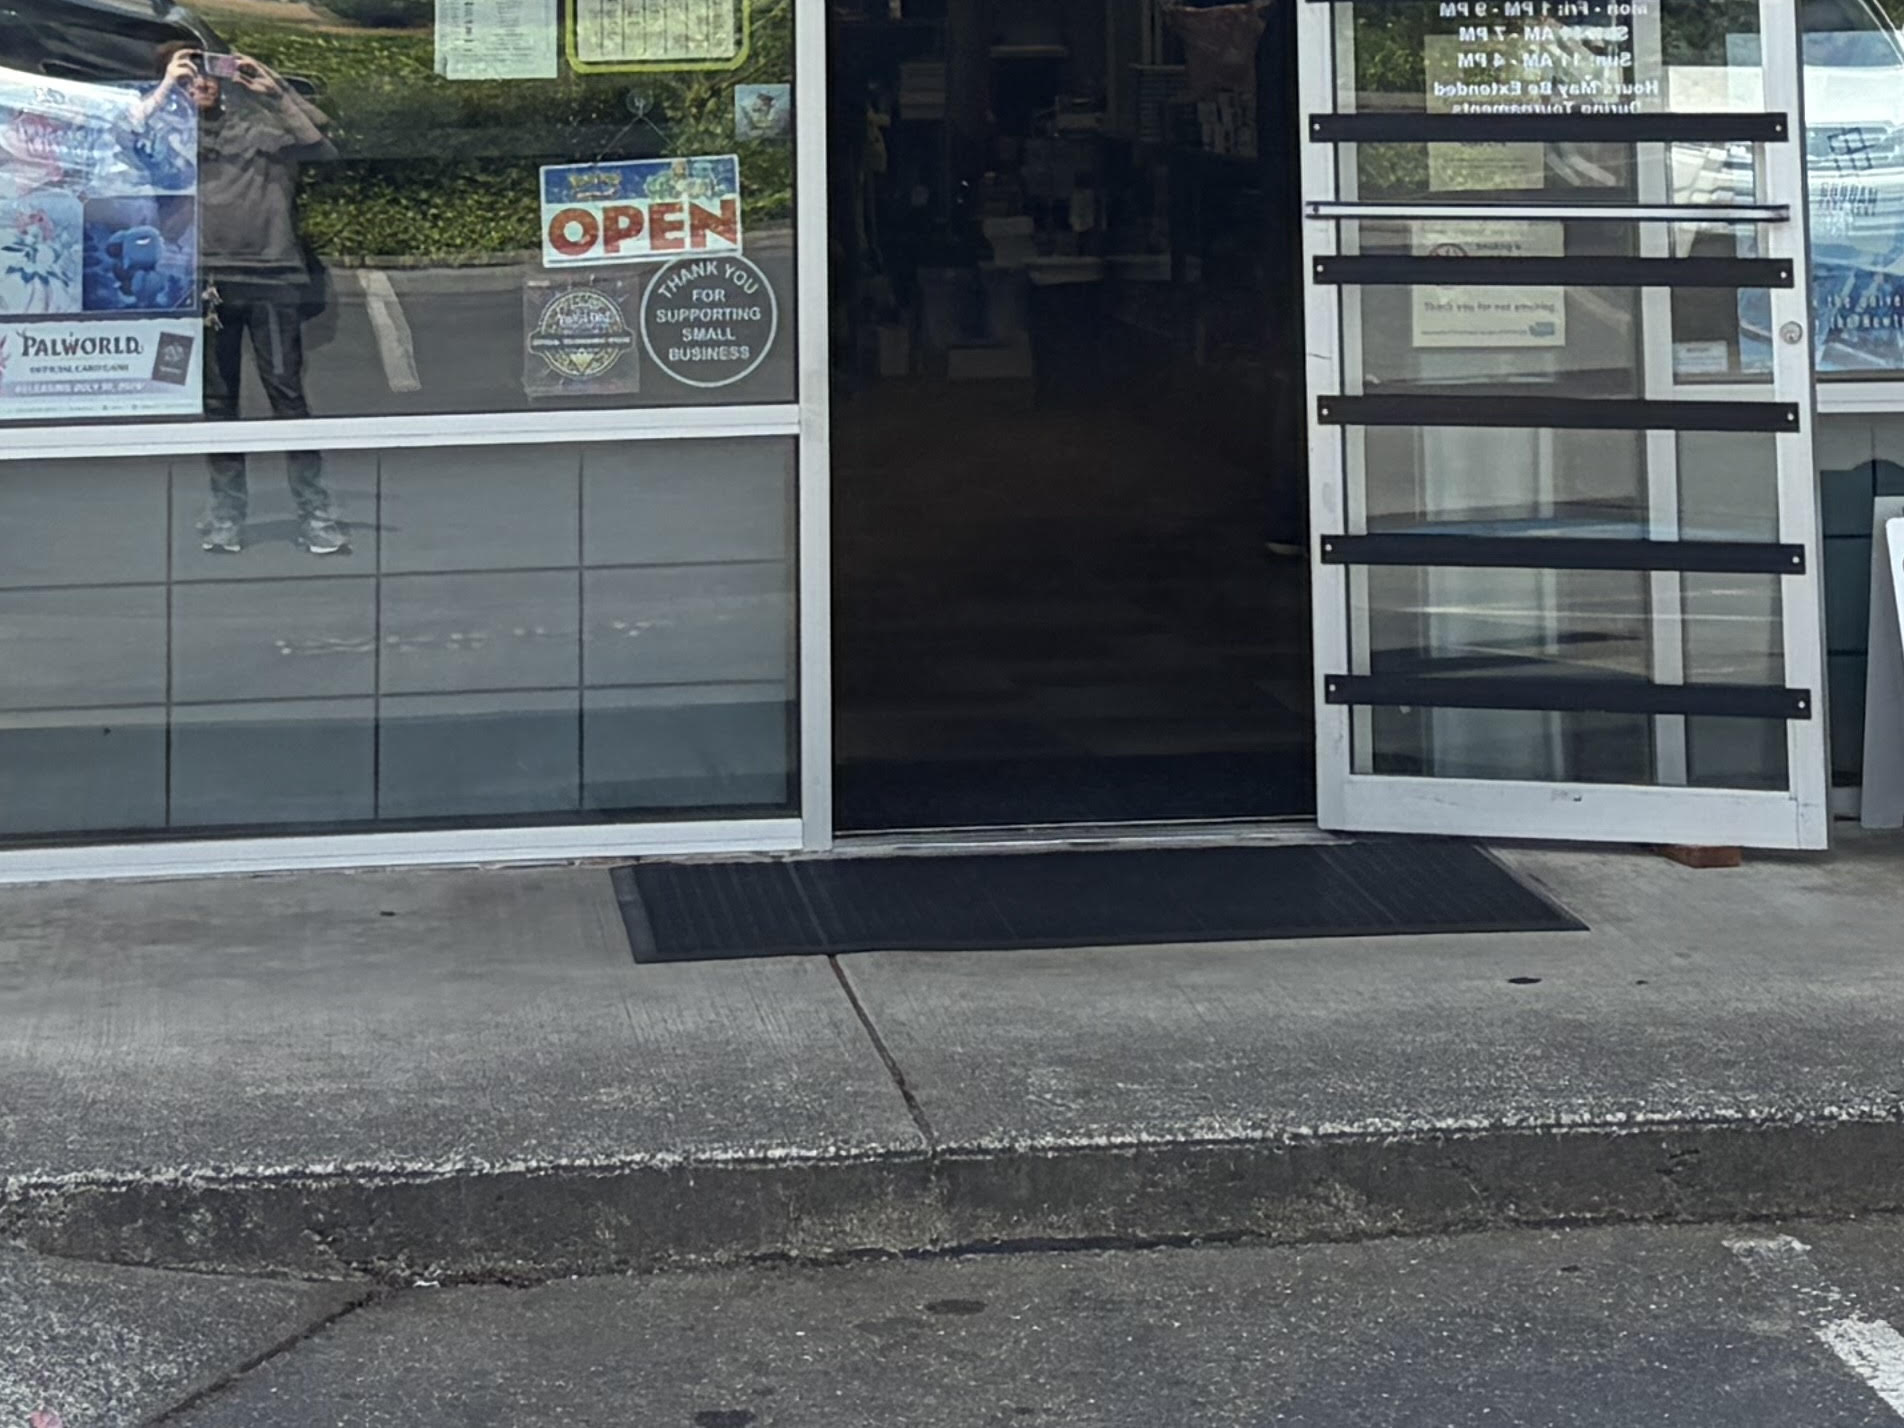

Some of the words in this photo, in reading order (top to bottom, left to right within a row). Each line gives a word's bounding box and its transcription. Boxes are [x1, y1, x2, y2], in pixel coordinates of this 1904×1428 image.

[548, 199, 737, 256] OPEN
[658, 261, 718, 299] THANK
[723, 263, 759, 295] YOU
[692, 289, 726, 302] FOR
[656, 307, 761, 323] SUPPORTING
[682, 327, 736, 342] SMALL
[17, 330, 143, 357] PALWORLD
[669, 345, 750, 361] BUSINESS
